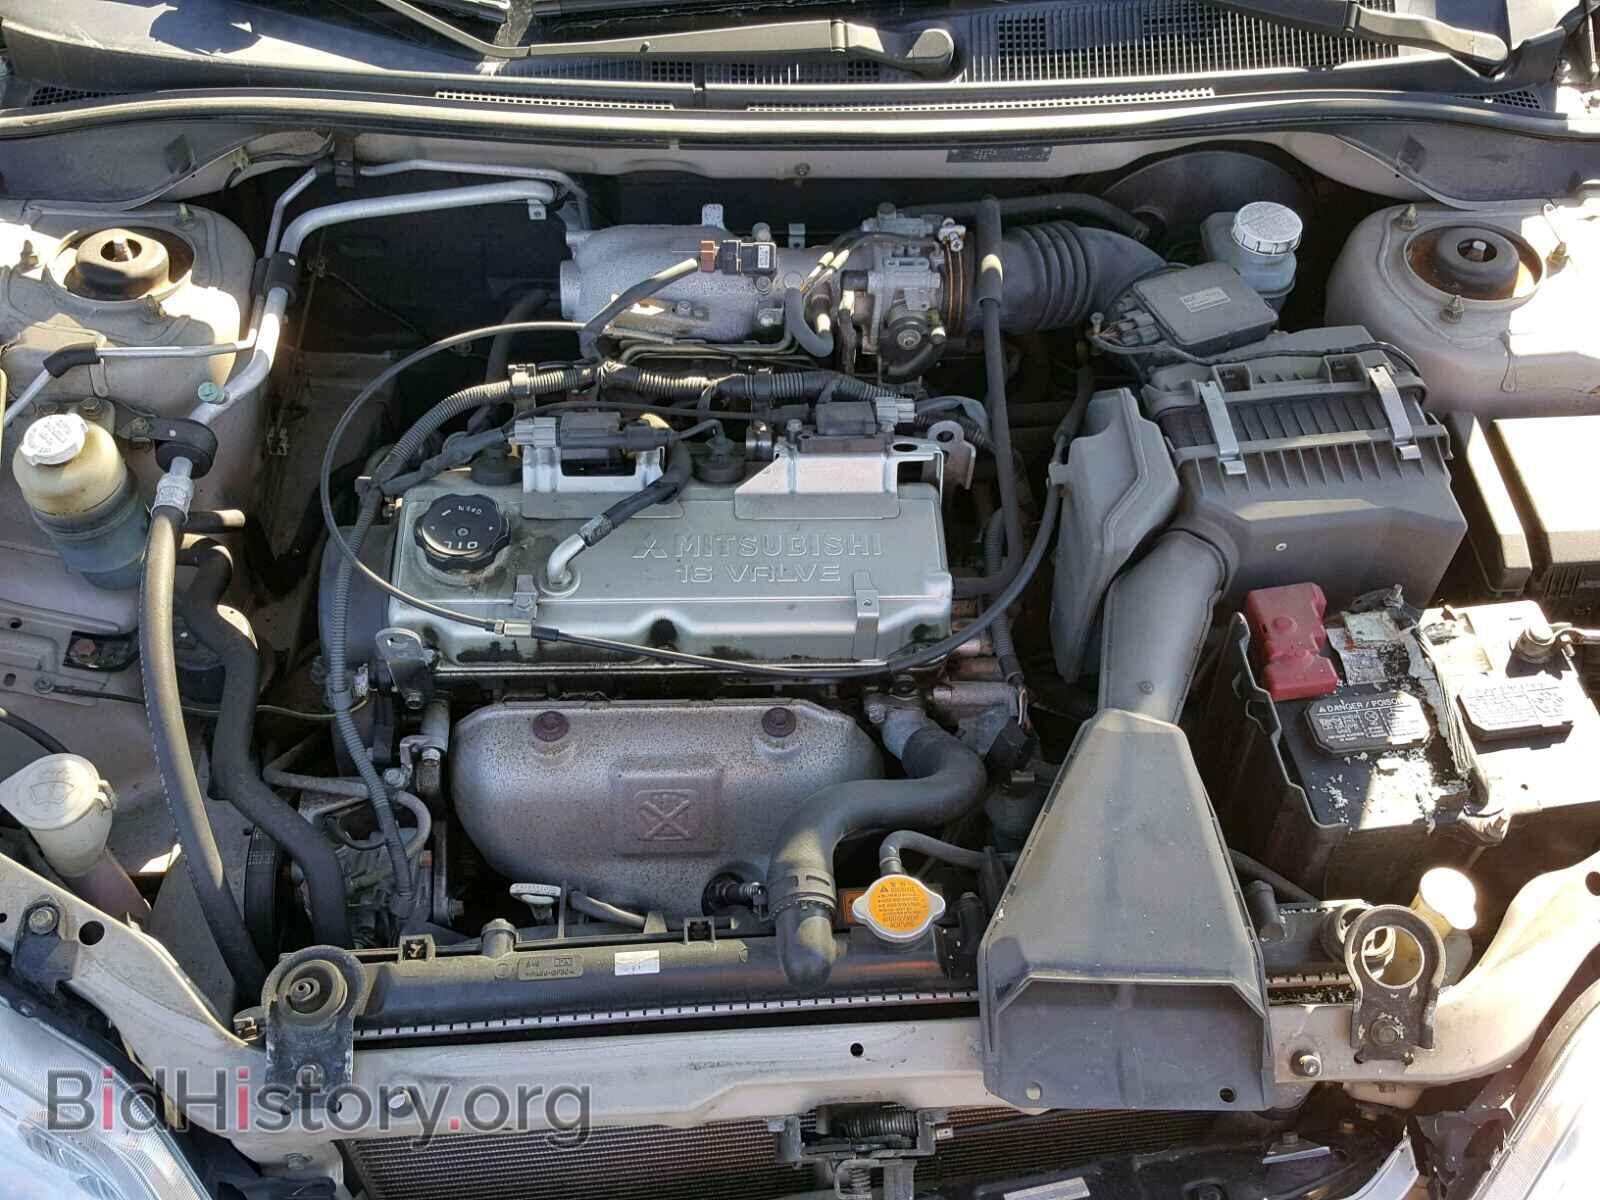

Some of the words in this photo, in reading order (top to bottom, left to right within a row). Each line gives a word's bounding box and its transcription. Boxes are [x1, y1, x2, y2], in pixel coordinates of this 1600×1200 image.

[443, 540, 478, 549] OIL
[674, 535, 882, 558] MITSUBISHI
[674, 564, 713, 583] 16
[726, 563, 841, 583] VALVE
[1326, 701, 1363, 713] DANGER
